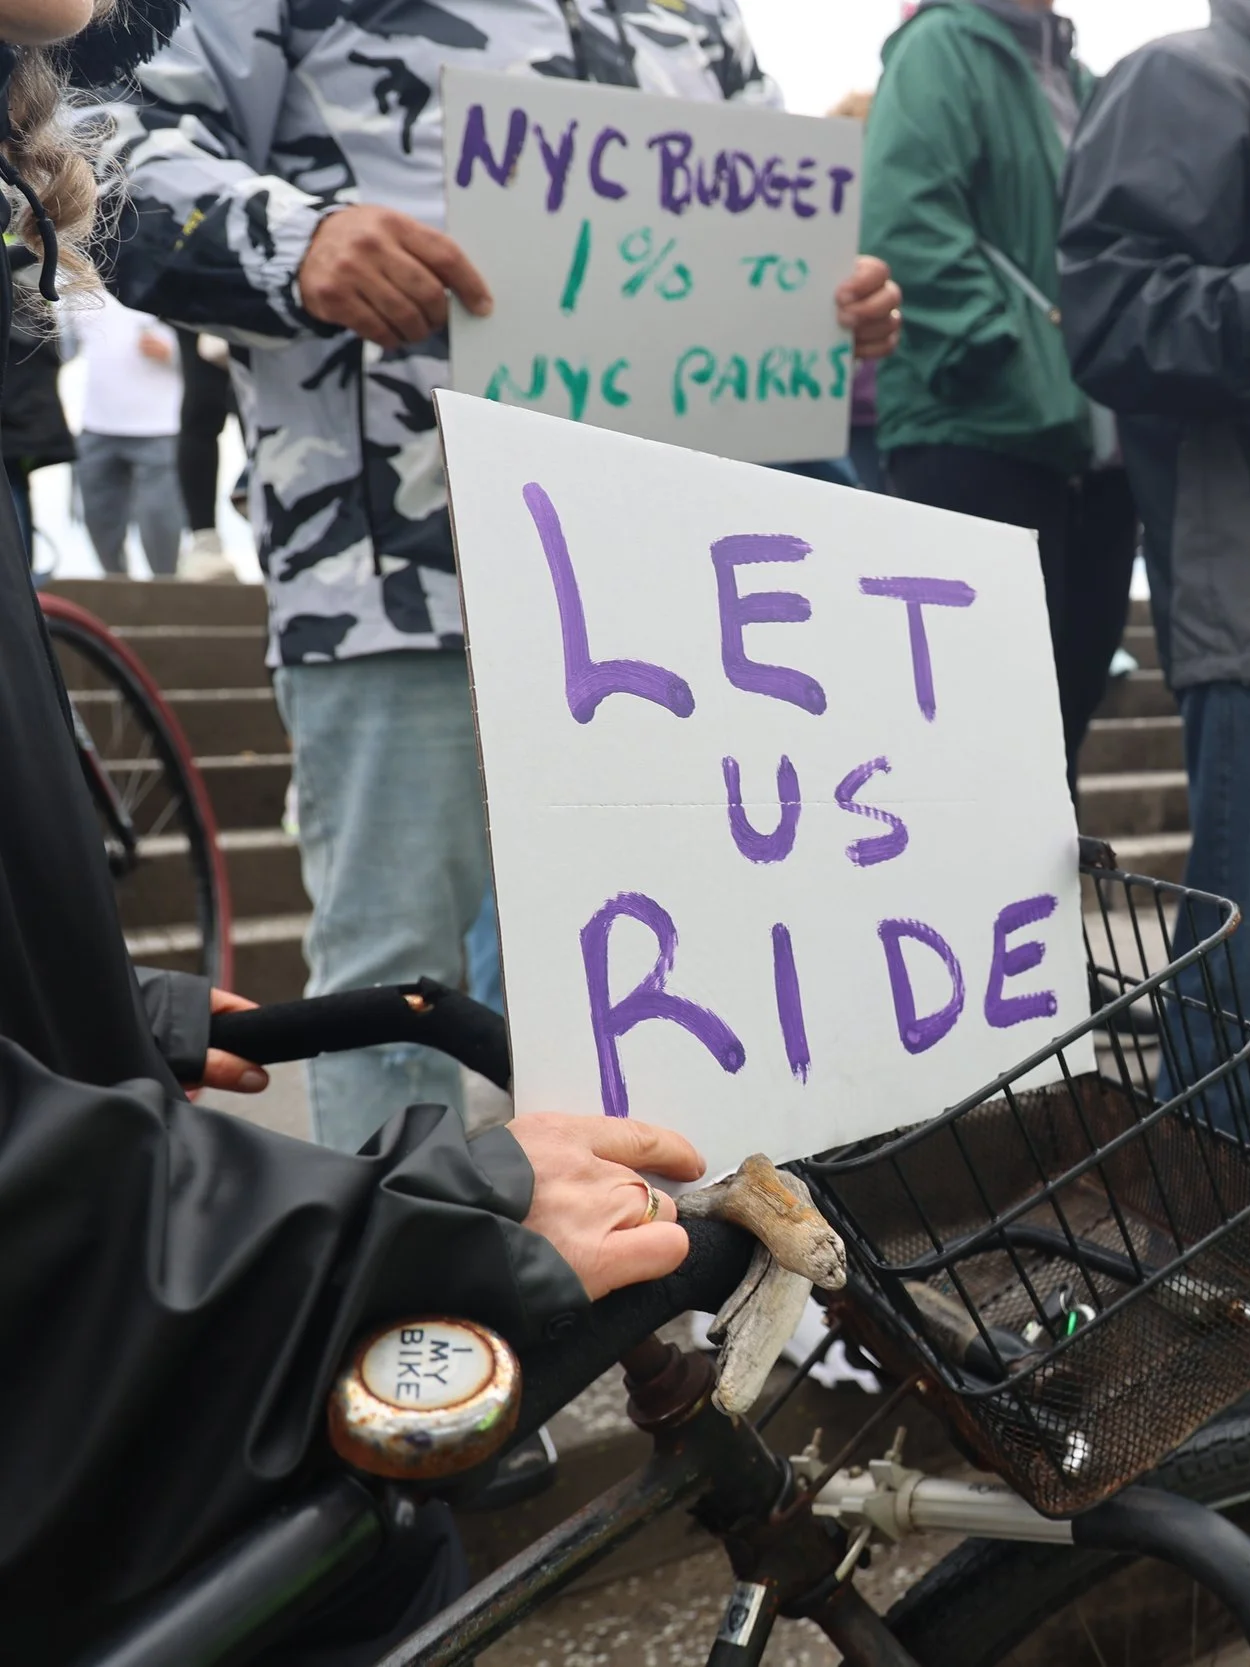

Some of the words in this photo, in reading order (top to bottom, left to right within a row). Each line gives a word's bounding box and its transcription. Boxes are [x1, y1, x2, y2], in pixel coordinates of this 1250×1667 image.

[455, 104, 628, 213] NYC
[646, 130, 855, 218] BUDGET
[739, 253, 810, 292] TO
[484, 354, 631, 421] NYC
[671, 345, 852, 417] PARKS
[522, 481, 978, 724] LET
[721, 754, 909, 868] US
[579, 890, 1058, 1118] RIDE
[395, 1328, 425, 1400] BIKE
[423, 1339, 450, 1386] MY
